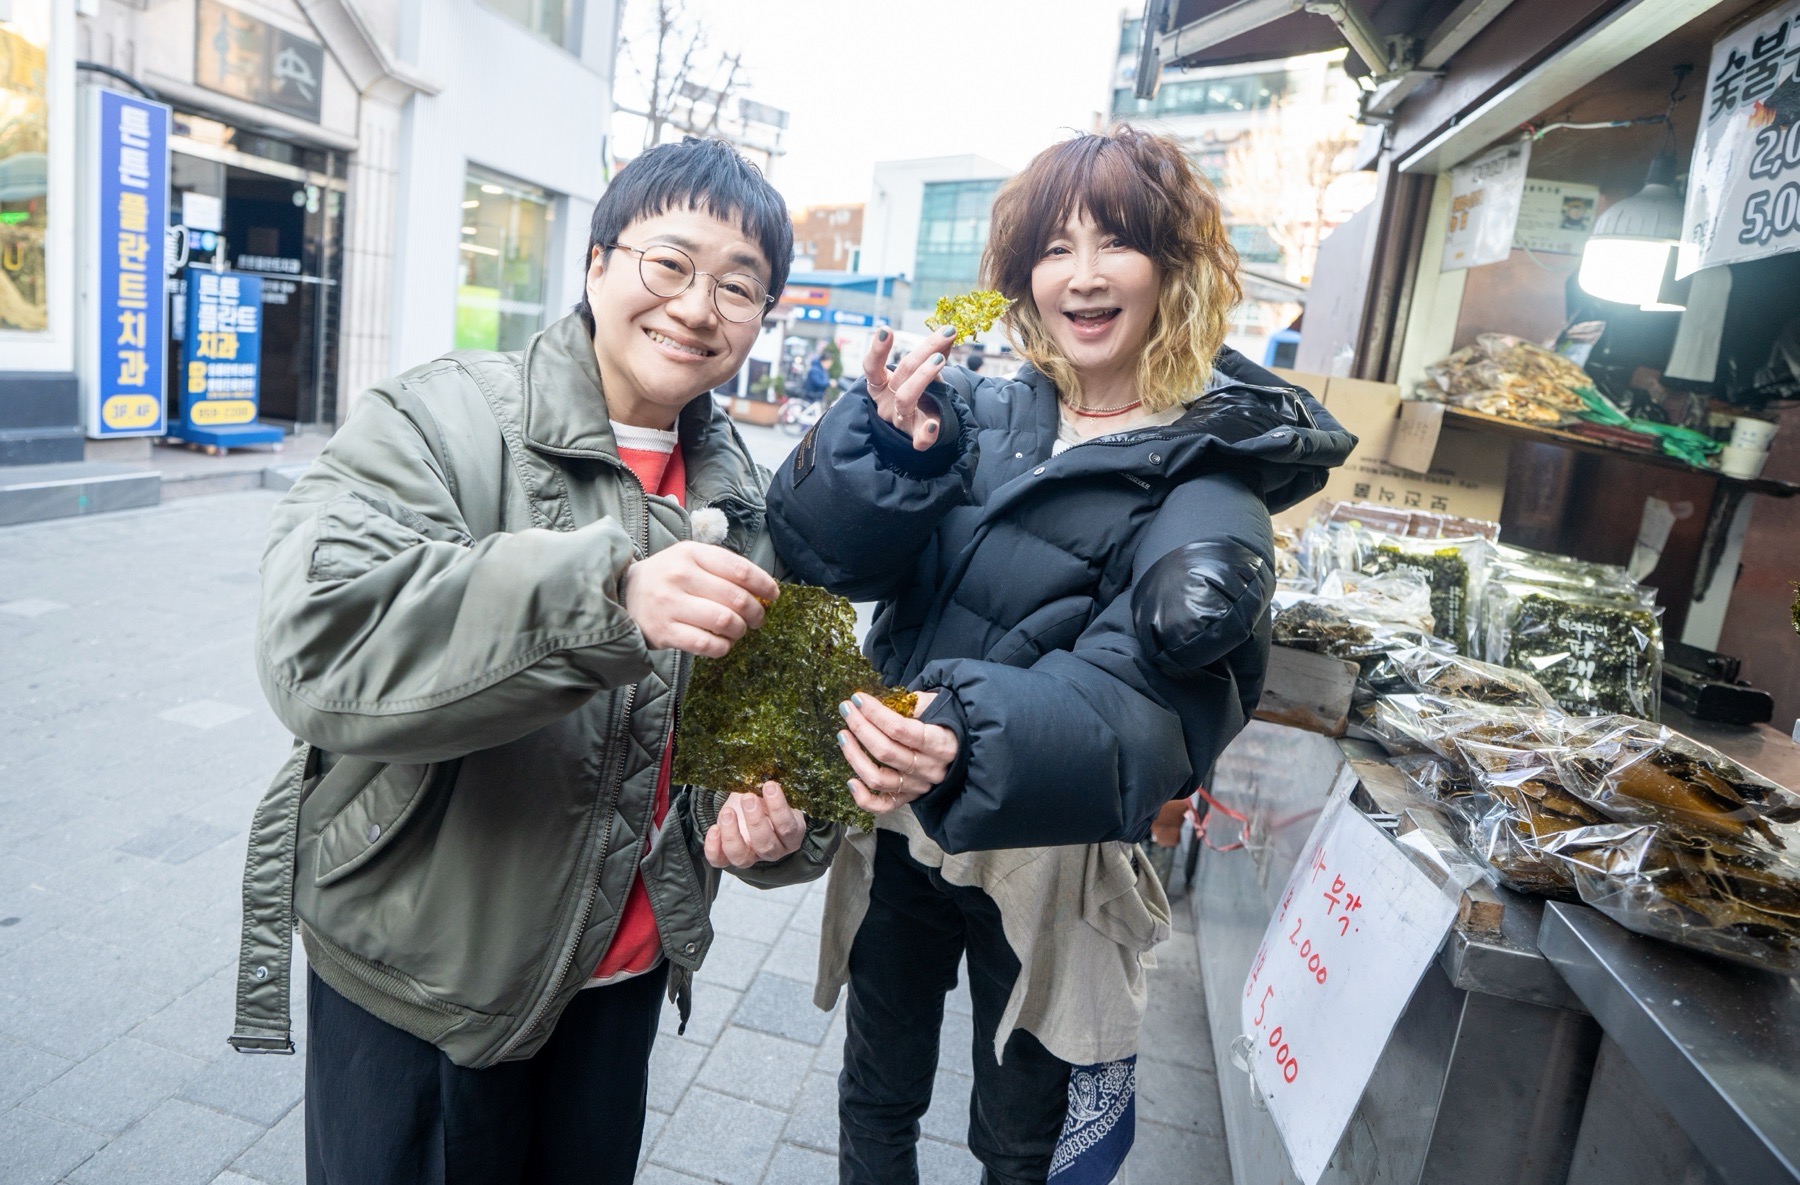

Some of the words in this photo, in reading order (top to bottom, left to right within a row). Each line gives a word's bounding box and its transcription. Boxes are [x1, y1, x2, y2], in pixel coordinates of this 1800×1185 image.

[1707, 14, 1800, 127] 숯불
[1739, 181, 1800, 246] 5,0
[197, 331, 240, 360] 치과
